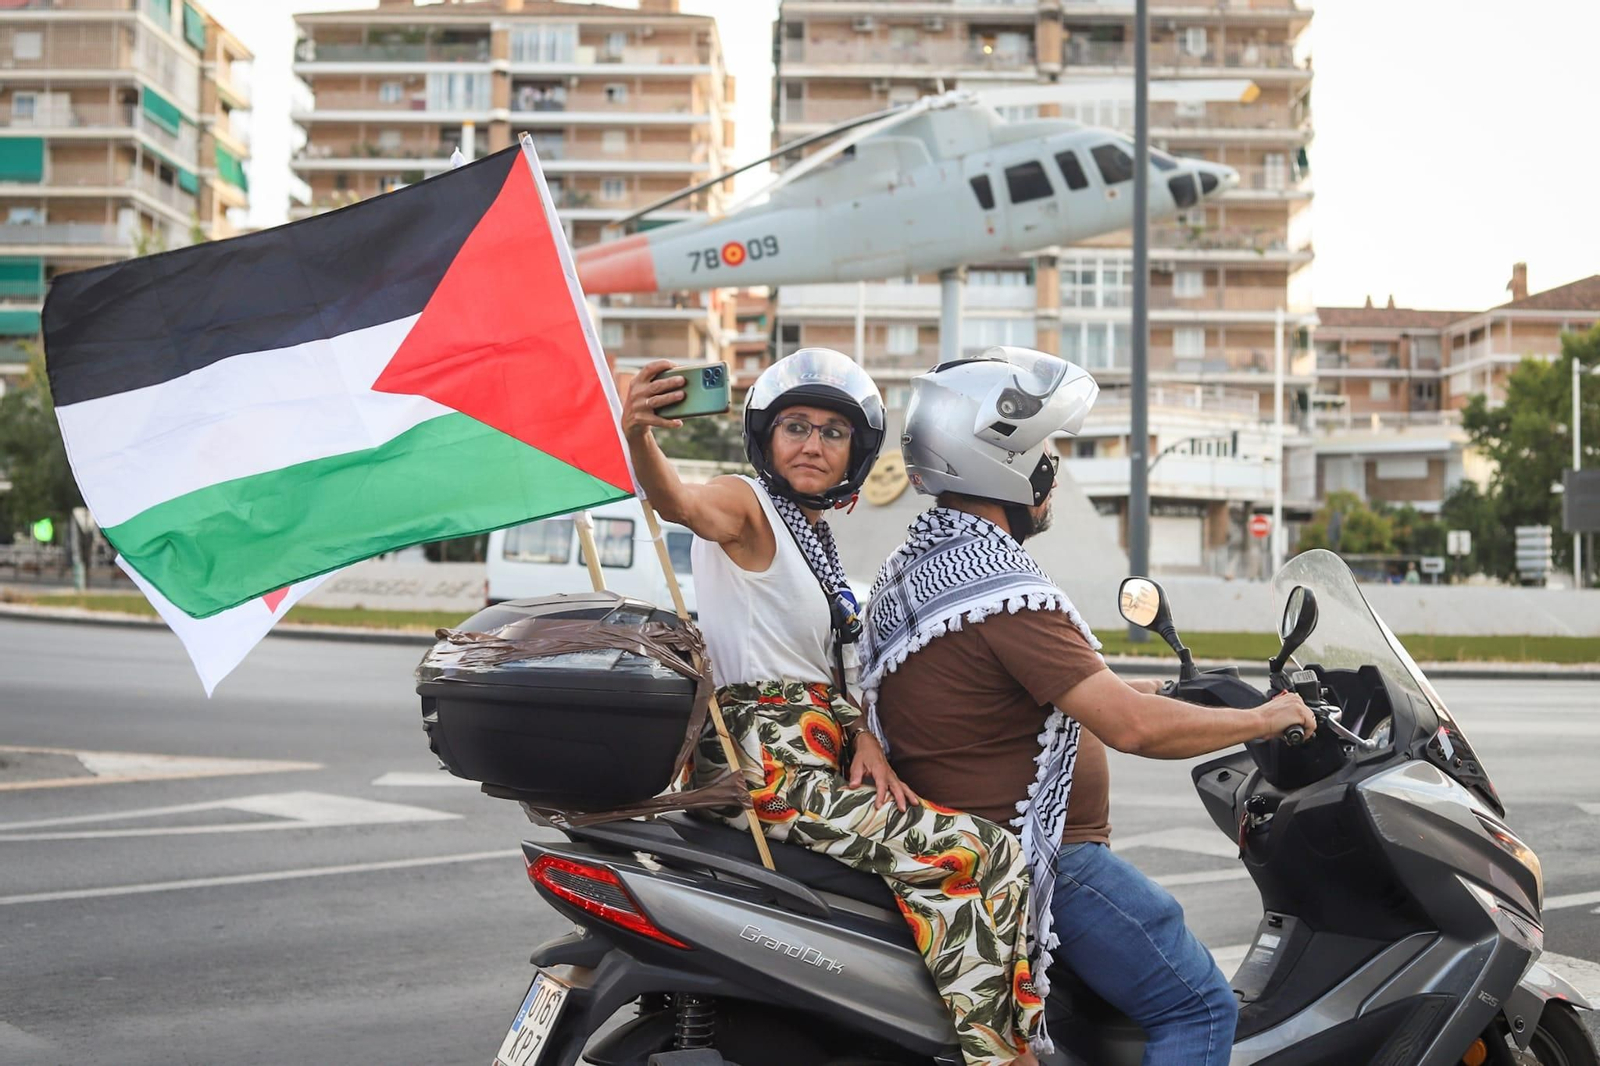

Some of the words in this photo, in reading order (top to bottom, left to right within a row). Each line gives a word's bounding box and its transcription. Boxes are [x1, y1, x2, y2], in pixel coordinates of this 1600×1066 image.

[687, 248, 720, 273] 78
[747, 235, 780, 261] 09
[739, 924, 804, 958] Grand
[801, 947, 845, 974] Dink
[1477, 990, 1500, 1007] 125
